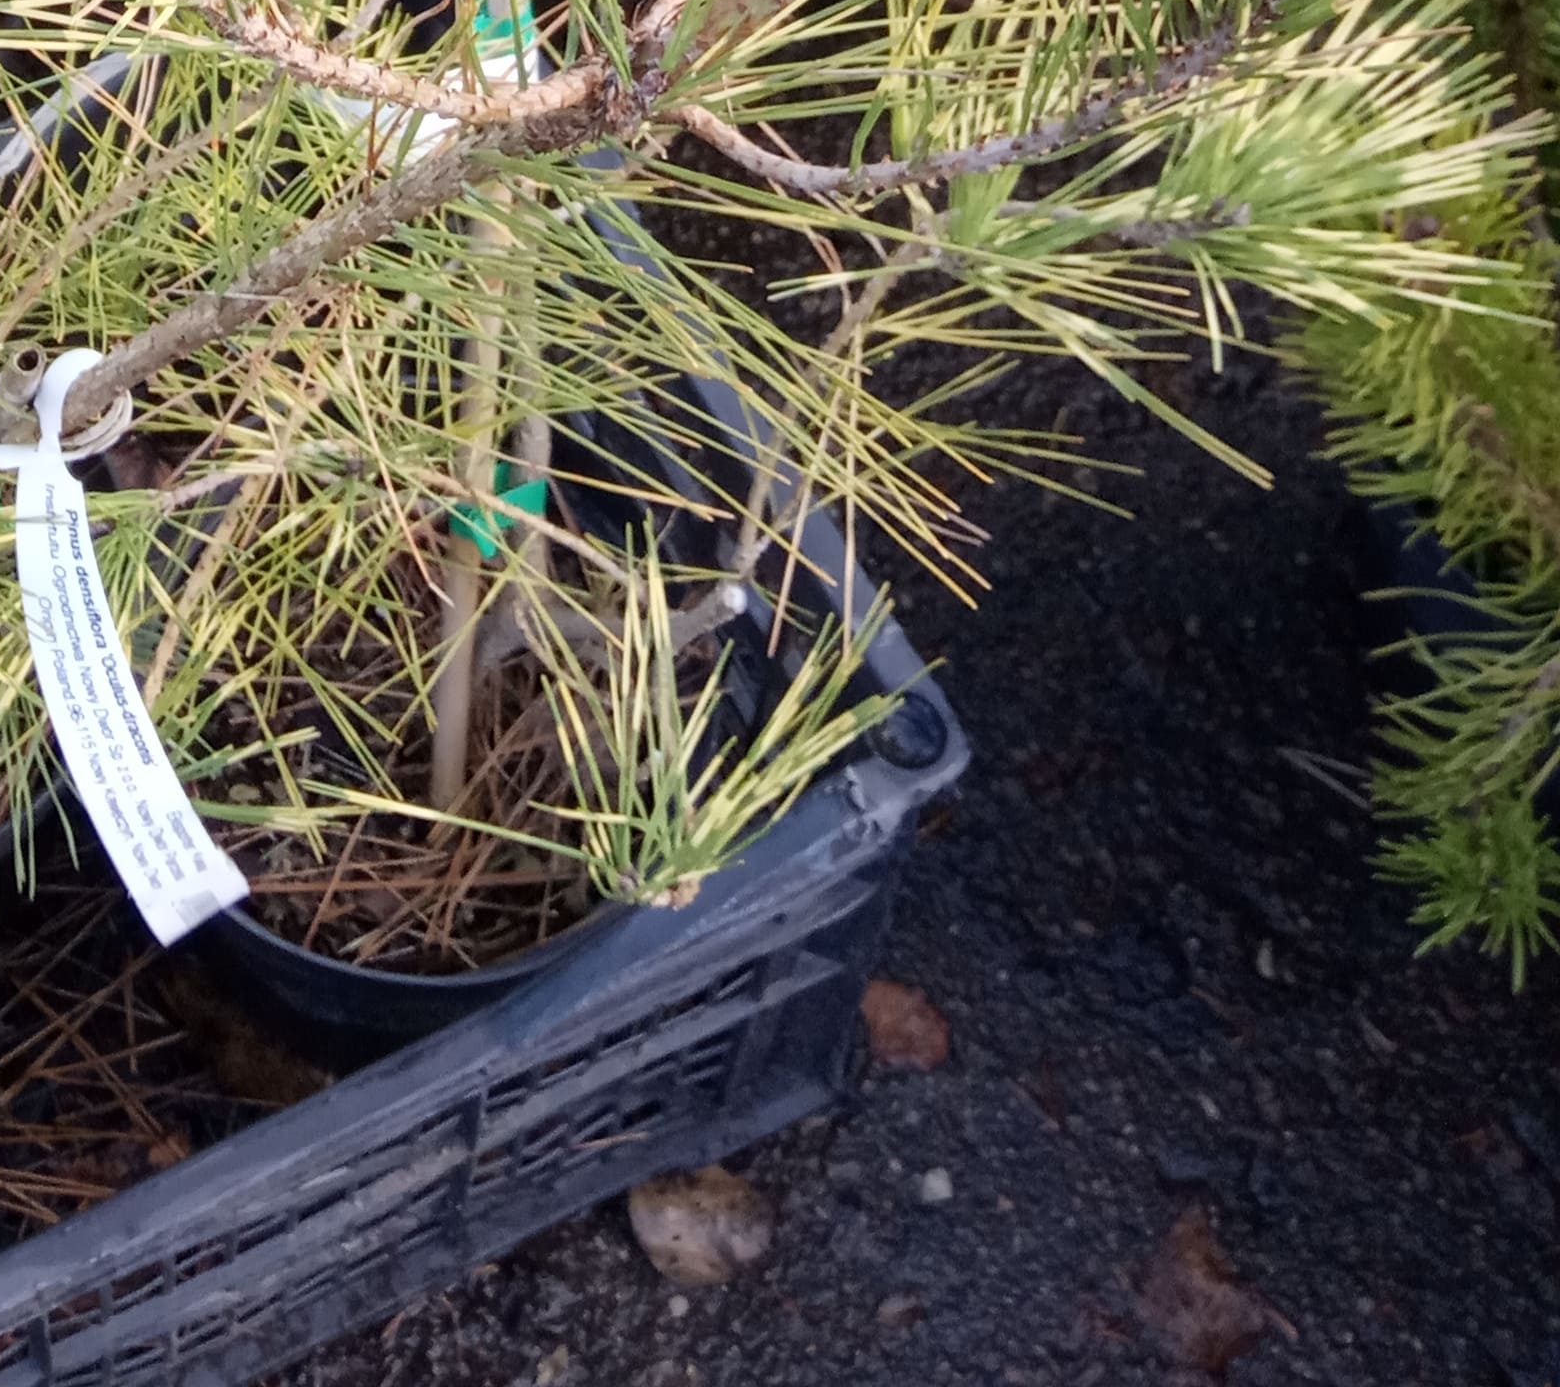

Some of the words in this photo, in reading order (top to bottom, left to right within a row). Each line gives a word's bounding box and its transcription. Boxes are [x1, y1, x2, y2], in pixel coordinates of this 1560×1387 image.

[52, 564, 85, 661] Ogrodnictwa
[79, 666, 99, 704] Nowy
[65, 509, 83, 560] Pinus
[76, 565, 107, 648] densiflora
